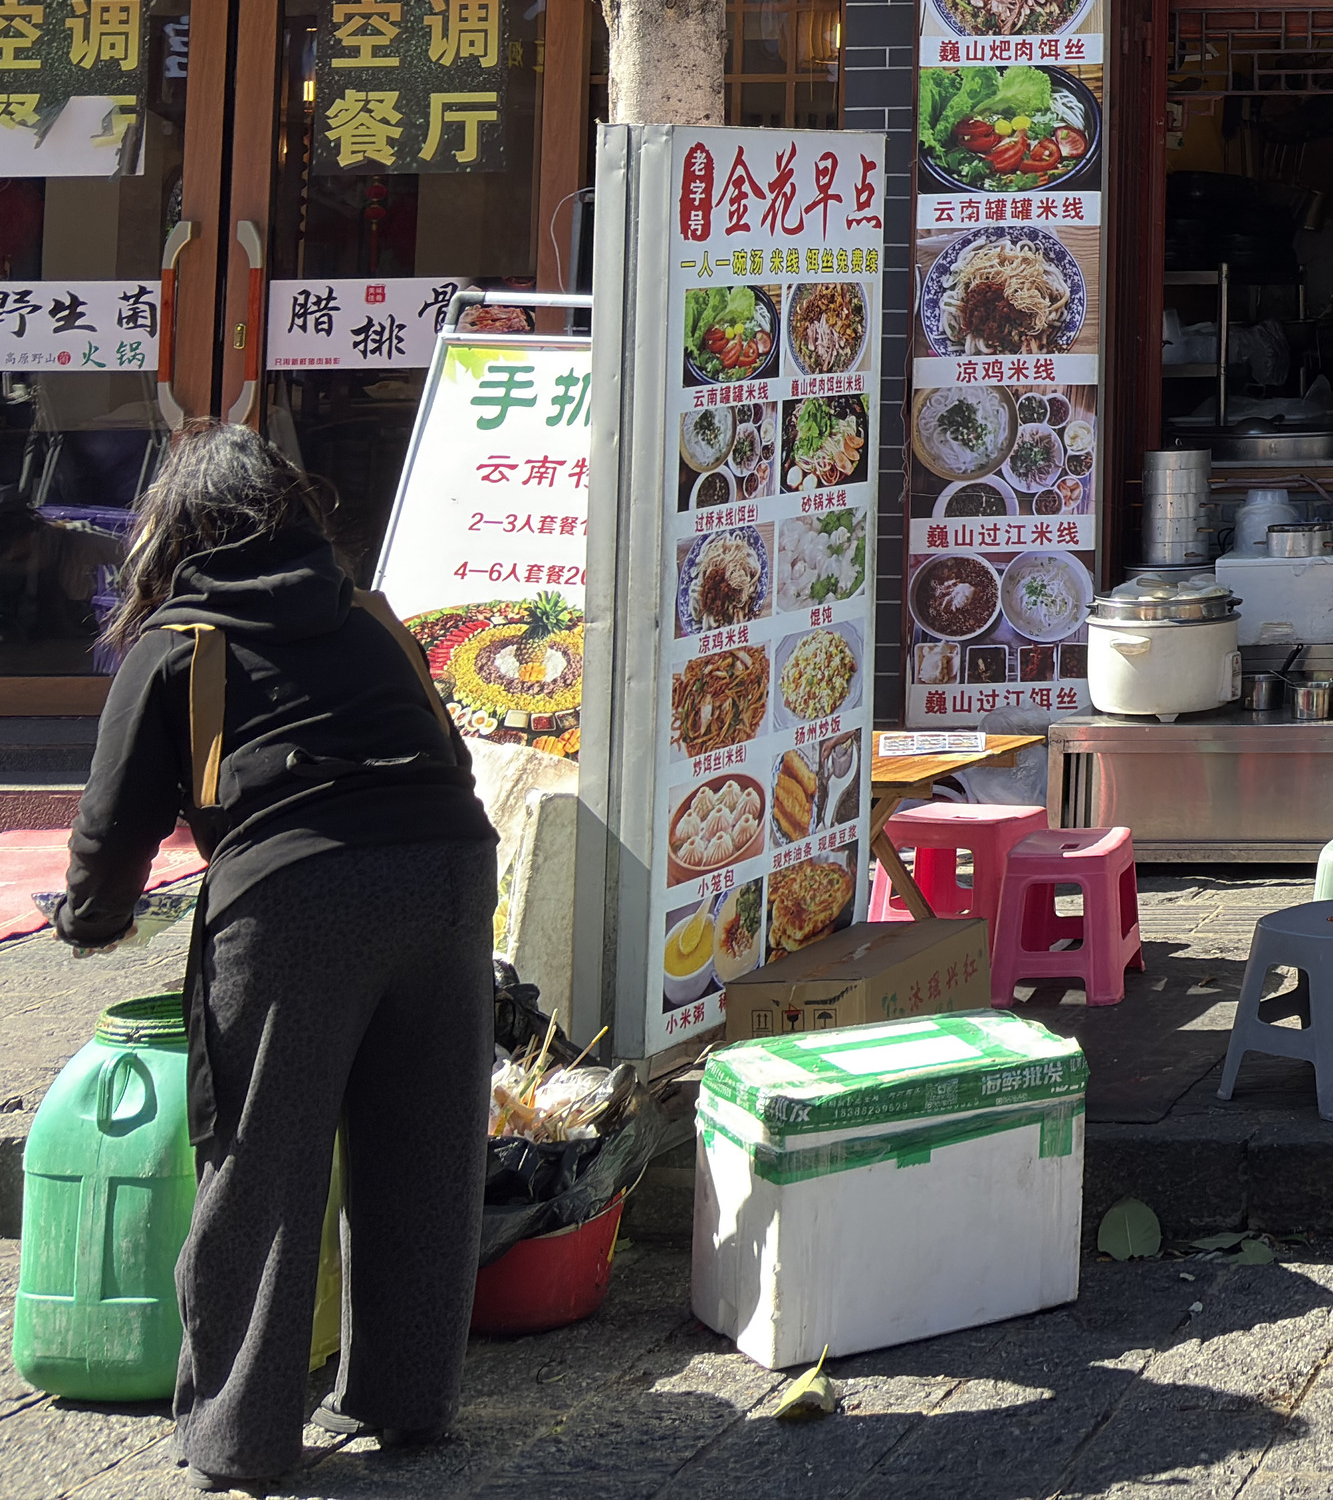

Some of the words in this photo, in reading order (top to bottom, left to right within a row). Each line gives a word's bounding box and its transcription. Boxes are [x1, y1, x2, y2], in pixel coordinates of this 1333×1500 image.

[324, 89, 502, 169] 餐厅
[688, 151, 709, 238] 老字号
[714, 140, 883, 242] 金花早点
[933, 196, 1085, 224] 云南罐罐米线
[680, 248, 764, 278] 一人一碗汤
[769, 248, 801, 274] 米线
[805, 247, 880, 275] 饵丝免费续
[80, 340, 147, 370] 火锅
[955, 357, 1057, 385] 凉鸡米线
[692, 382, 770, 408] 云南罐罐米线
[800, 489, 848, 514] 砂锅米线
[926, 521, 1080, 550] 巍山过江米线
[809, 605, 834, 626] 馄饨
[697, 624, 750, 654] 凉鸡米线
[924, 686, 1080, 716] 巍山过江饵丝
[794, 715, 842, 746] 扬州炒饭
[772, 841, 814, 870] 现炸油条
[817, 825, 858, 853] 现磨豆浆
[696, 868, 736, 899] 小笼包
[664, 1002, 706, 1036] 小米粥
